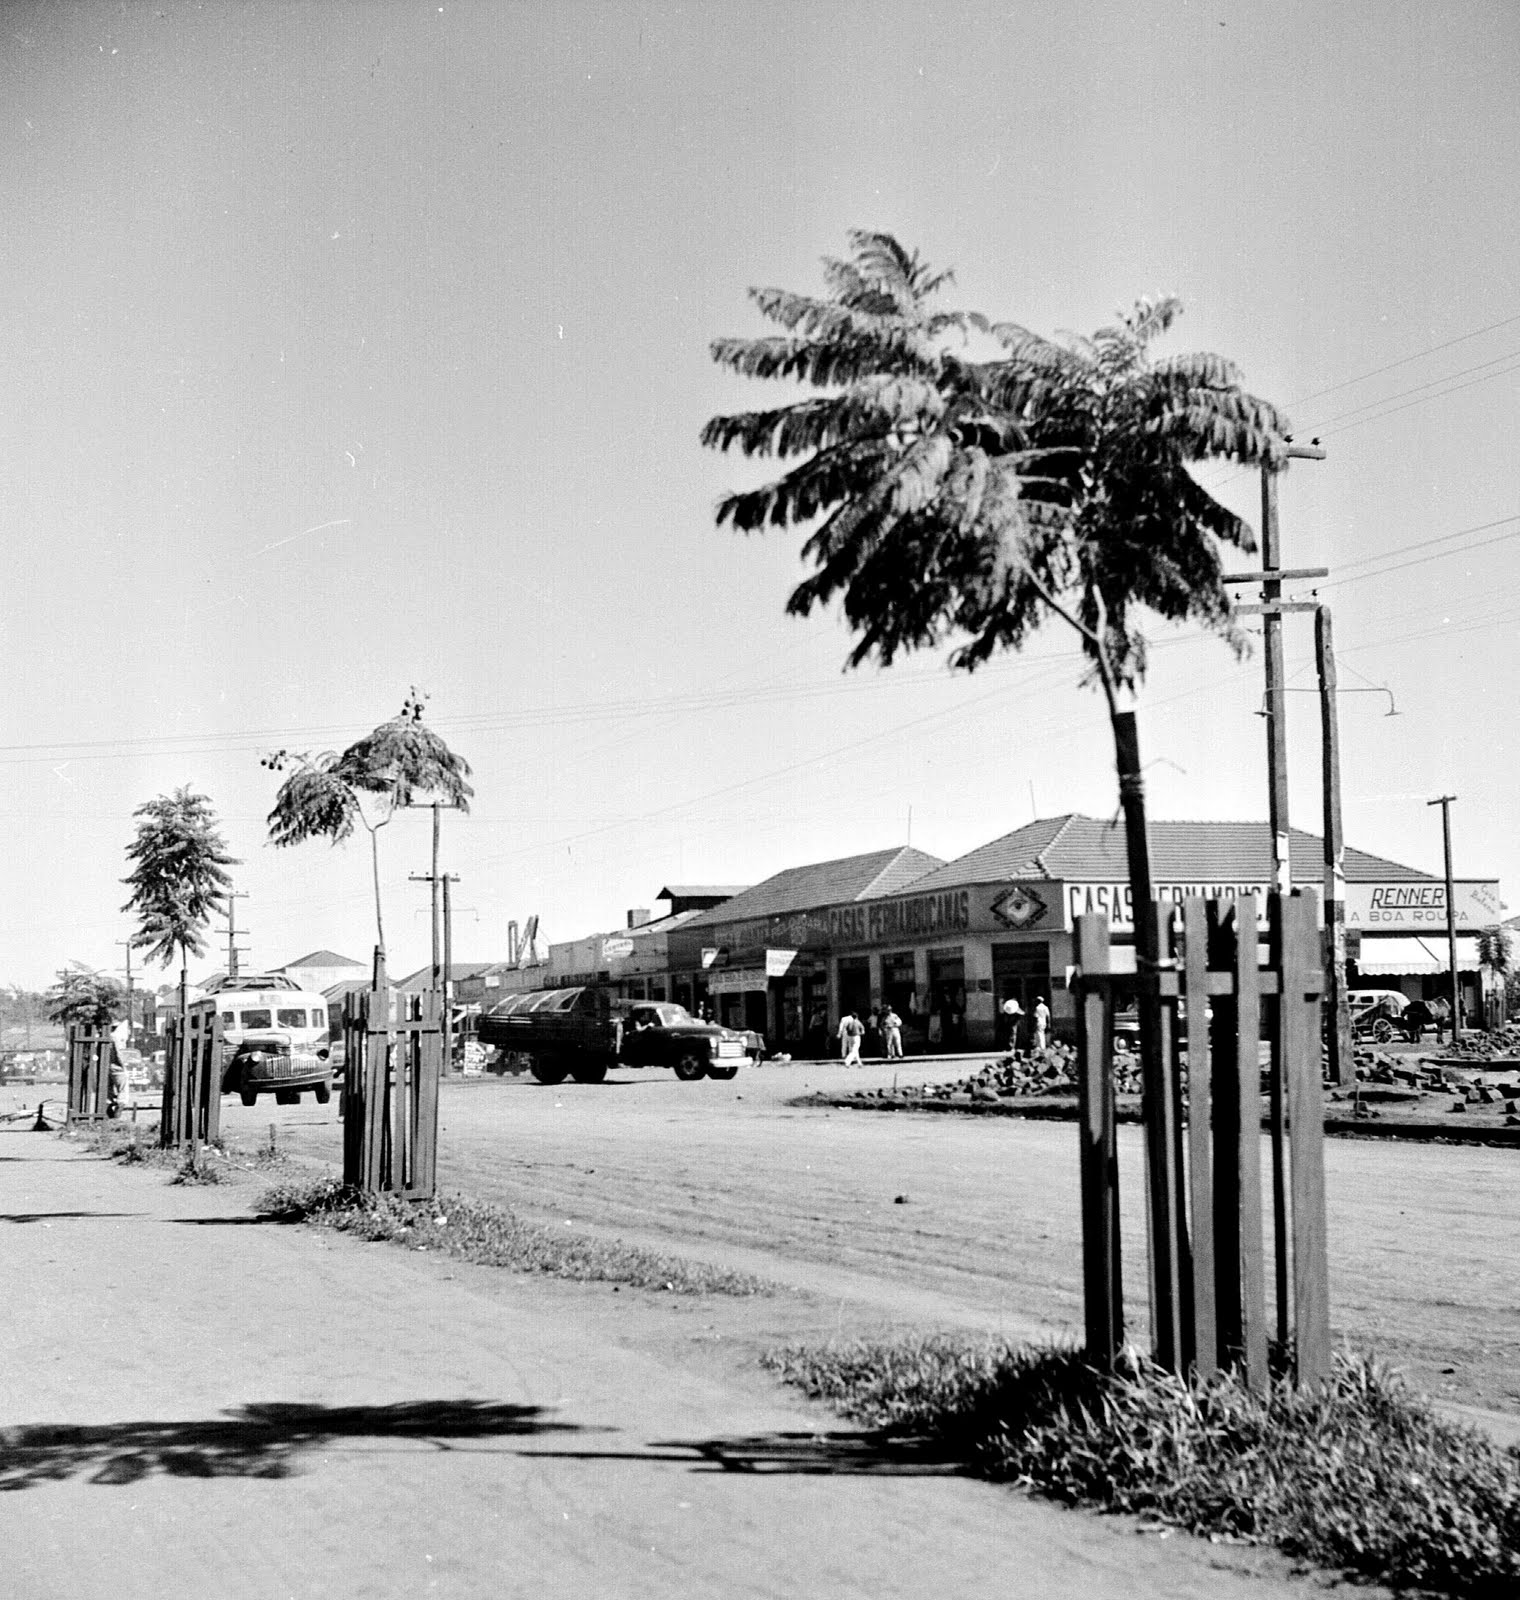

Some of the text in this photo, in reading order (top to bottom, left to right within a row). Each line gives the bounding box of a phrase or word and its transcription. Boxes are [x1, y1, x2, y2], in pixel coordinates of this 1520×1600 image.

[1069, 886, 1134, 924] CASAS
[1371, 887, 1445, 909] RENNER
[1350, 911, 1360, 922] A
[1369, 911, 1405, 922] BOA
